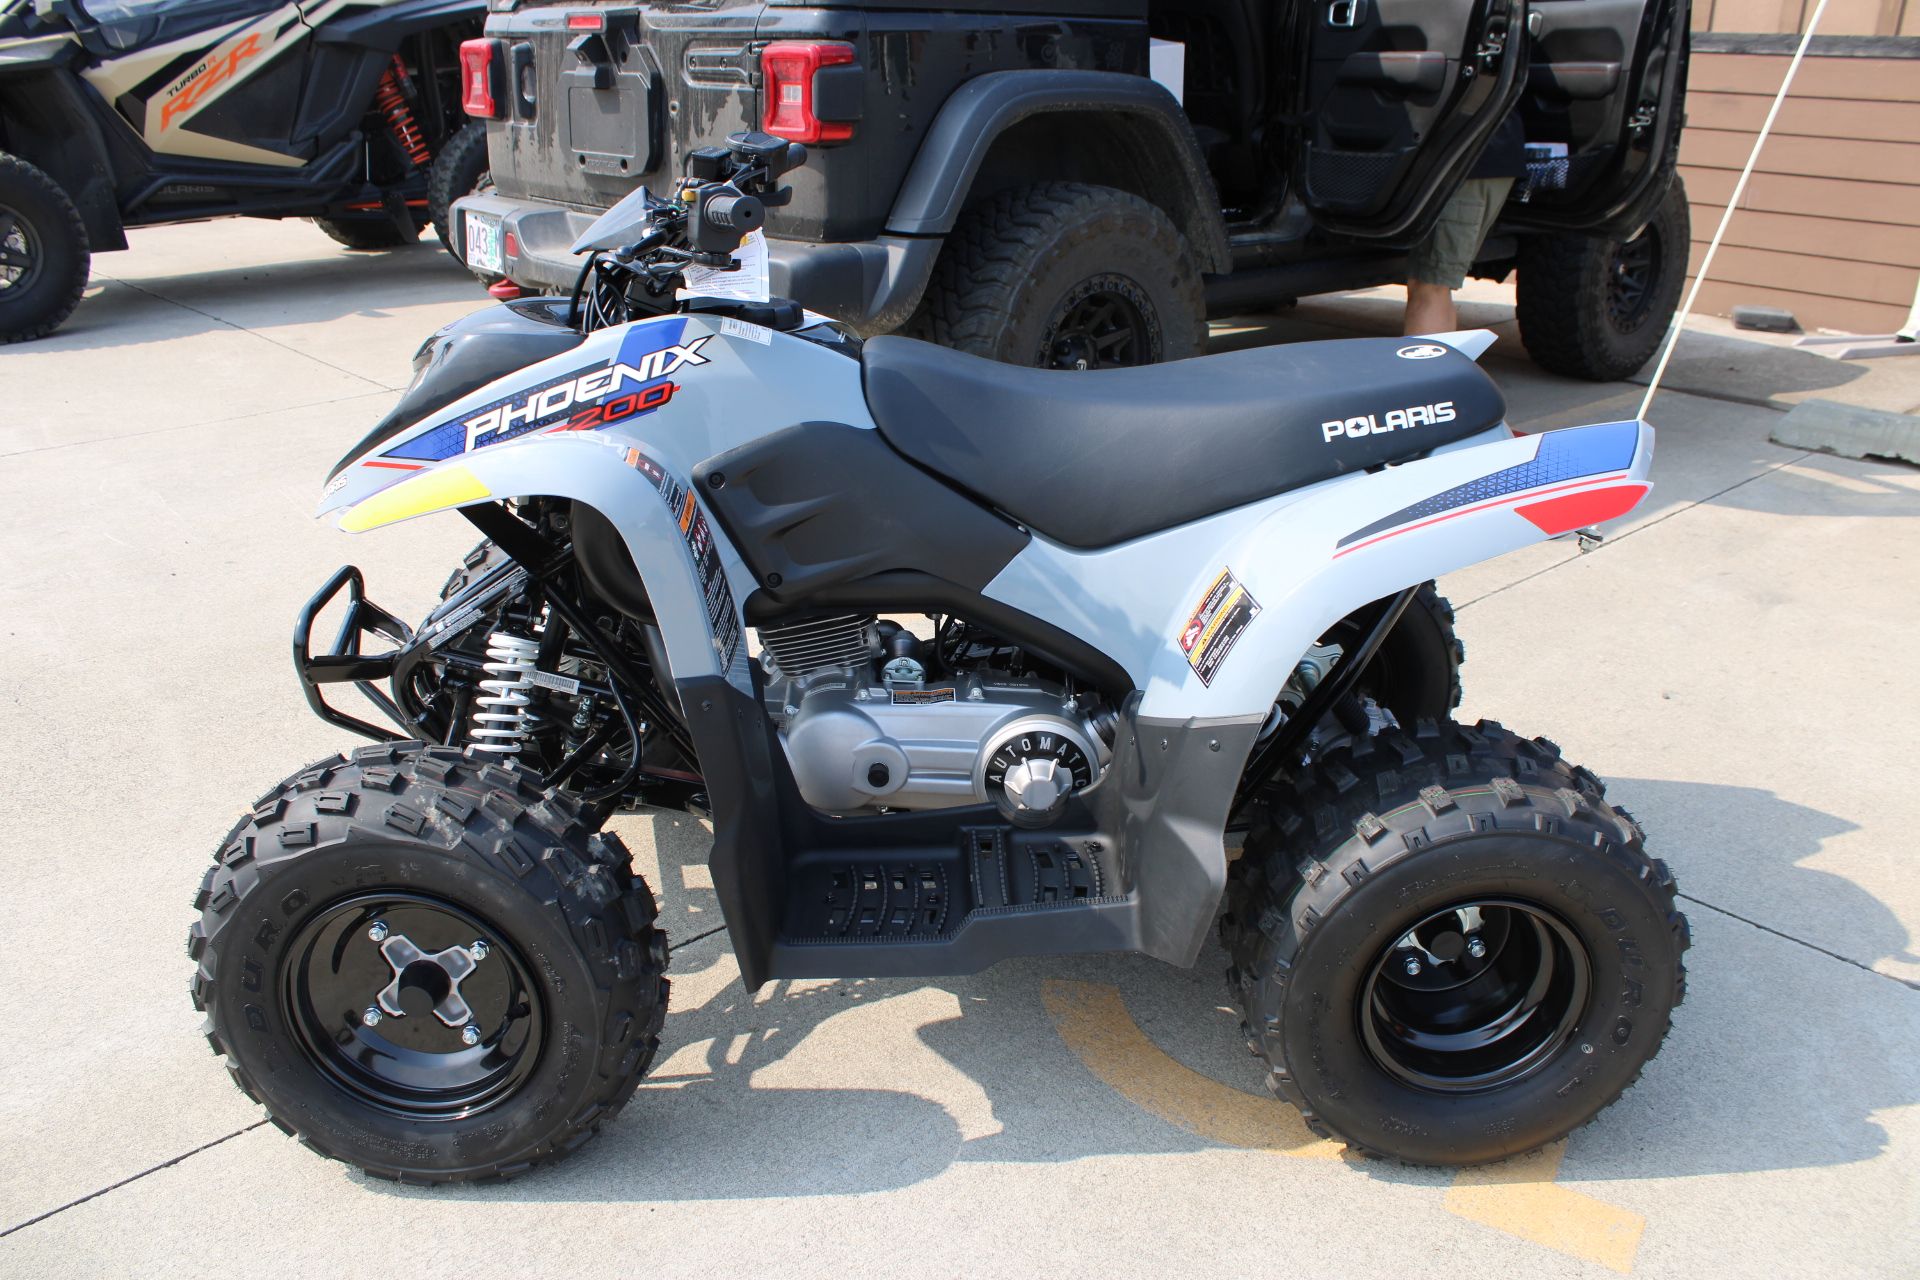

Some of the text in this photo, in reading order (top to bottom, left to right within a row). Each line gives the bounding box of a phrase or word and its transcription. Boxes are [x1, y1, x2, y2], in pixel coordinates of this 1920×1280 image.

[161, 31, 262, 133] RZR
[167, 63, 207, 97] TURBO
[468, 224, 488, 256] 043
[464, 334, 714, 453] PHOENIX
[563, 382, 681, 434] 200
[1321, 401, 1456, 443] POLARIS
[988, 736, 1087, 788] AUTOMATIC
[241, 888, 309, 1034] DURO
